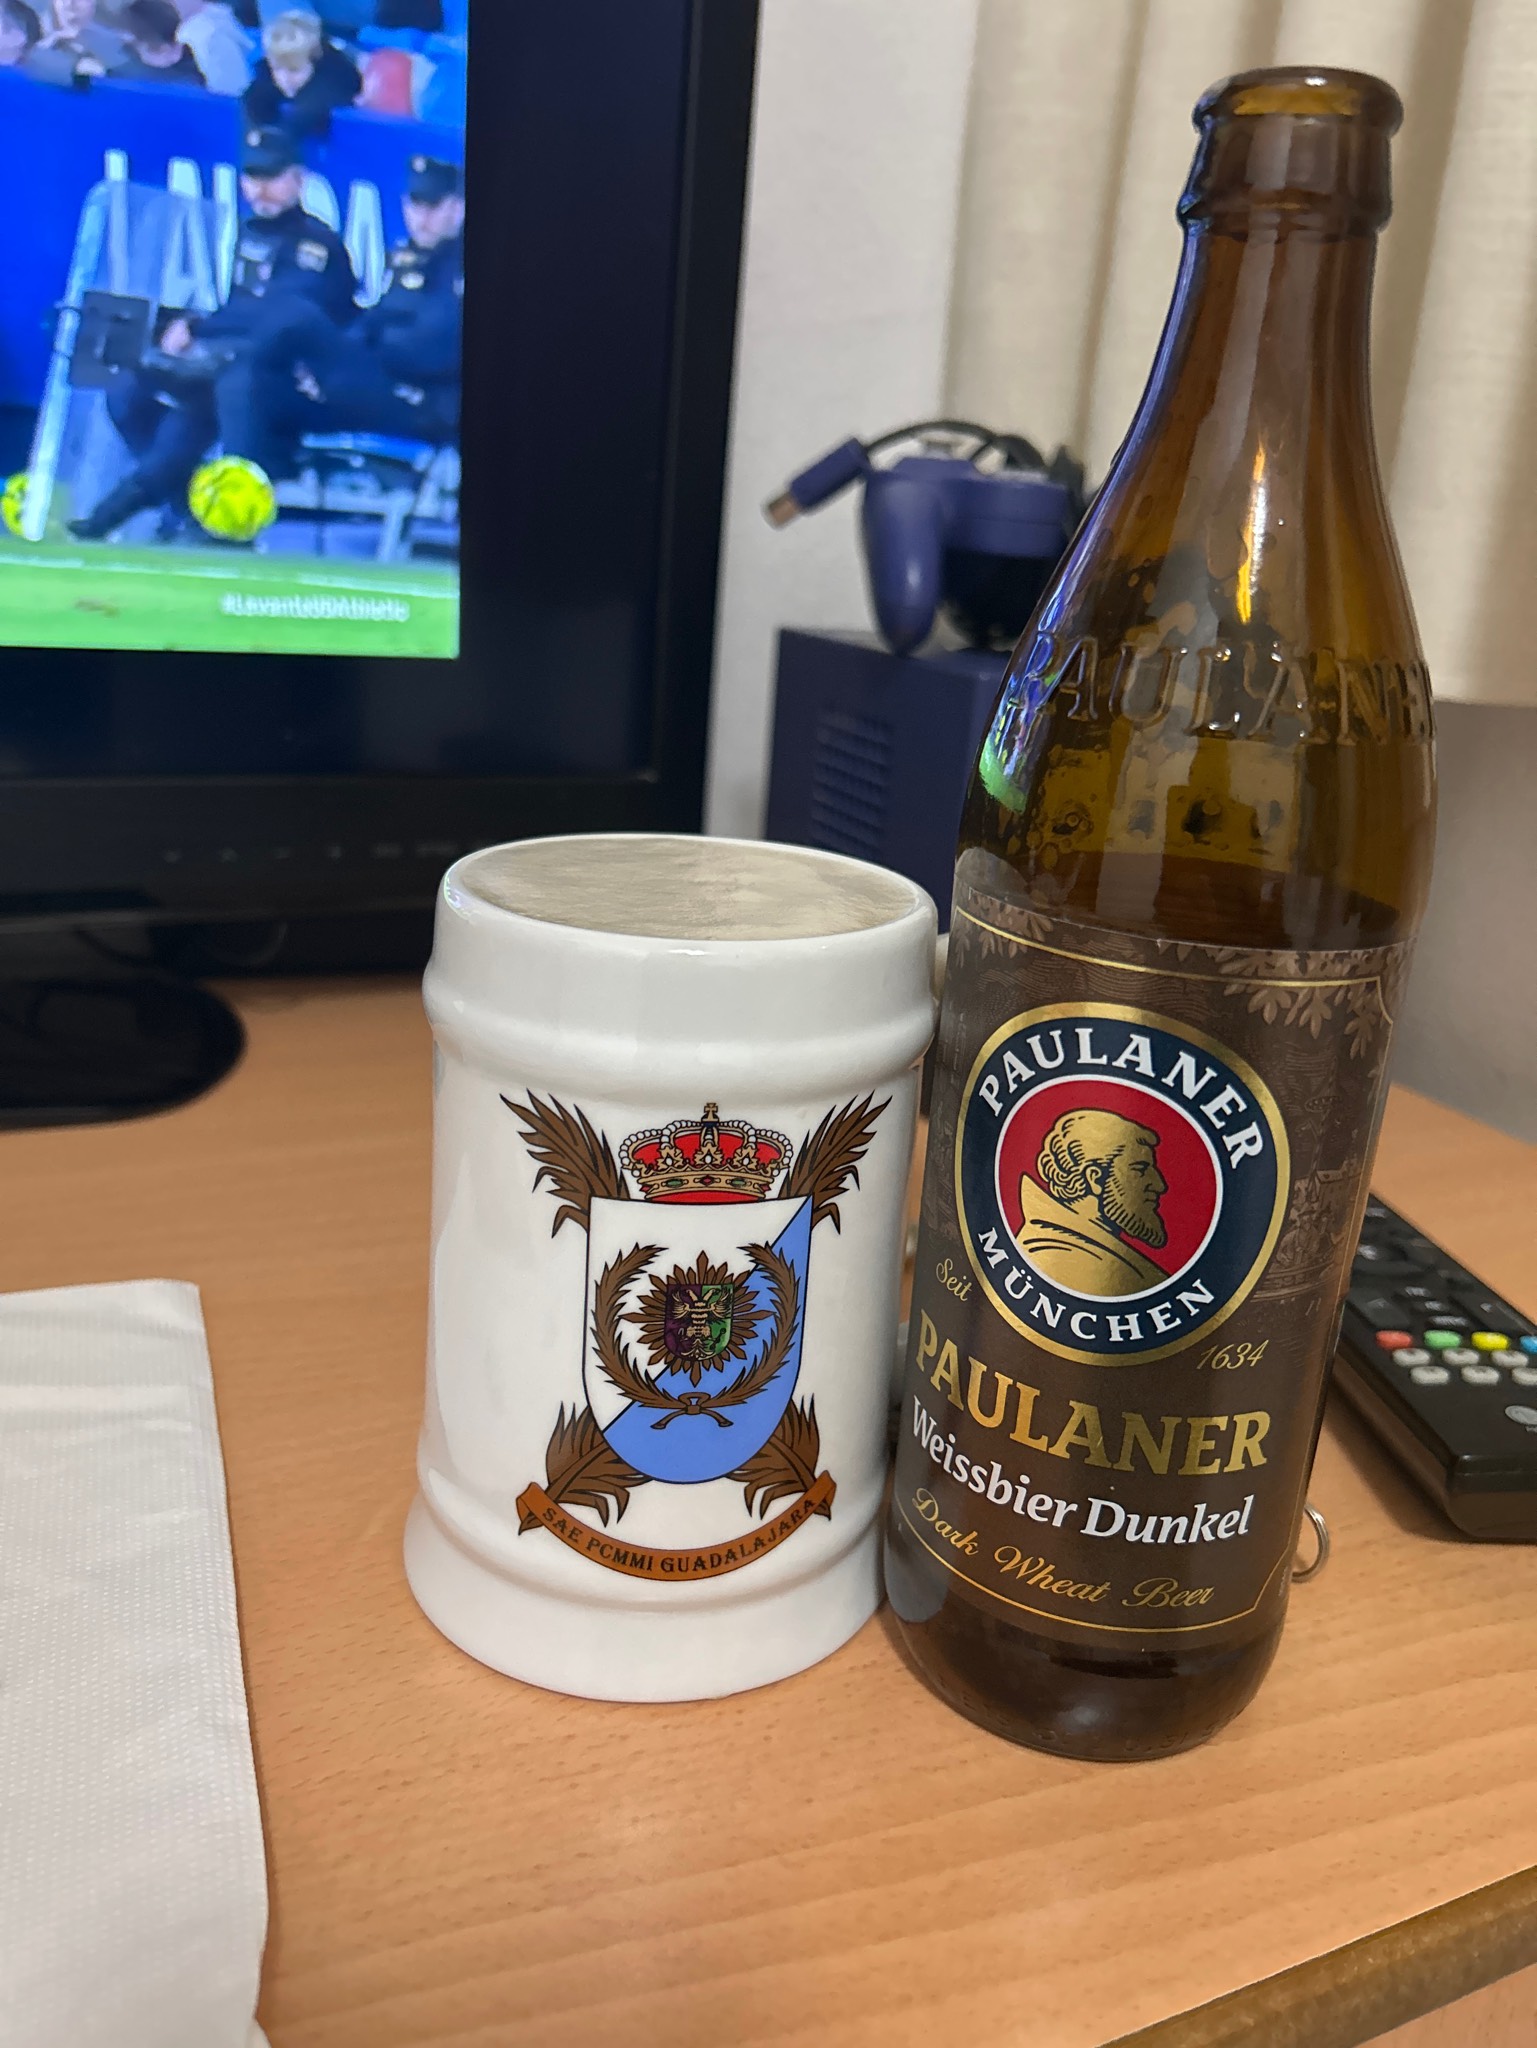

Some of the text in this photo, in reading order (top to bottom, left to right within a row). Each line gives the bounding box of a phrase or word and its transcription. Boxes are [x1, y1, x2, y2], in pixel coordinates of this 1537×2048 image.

[977, 1027, 1264, 1169] PAULANER
[936, 1258, 1269, 1371] Seit 1634
[977, 1227, 1215, 1342] MÜNCHEN
[915, 1308, 1271, 1476] PAULANER
[912, 1394, 1255, 1545] Weissbier Dunkel
[541, 1499, 816, 1573] SAE PCMMI GUADALAJARA
[912, 1487, 979, 1556] Dark
[994, 1545, 1112, 1604] Wheat
[1122, 1577, 1215, 1608] Beer
